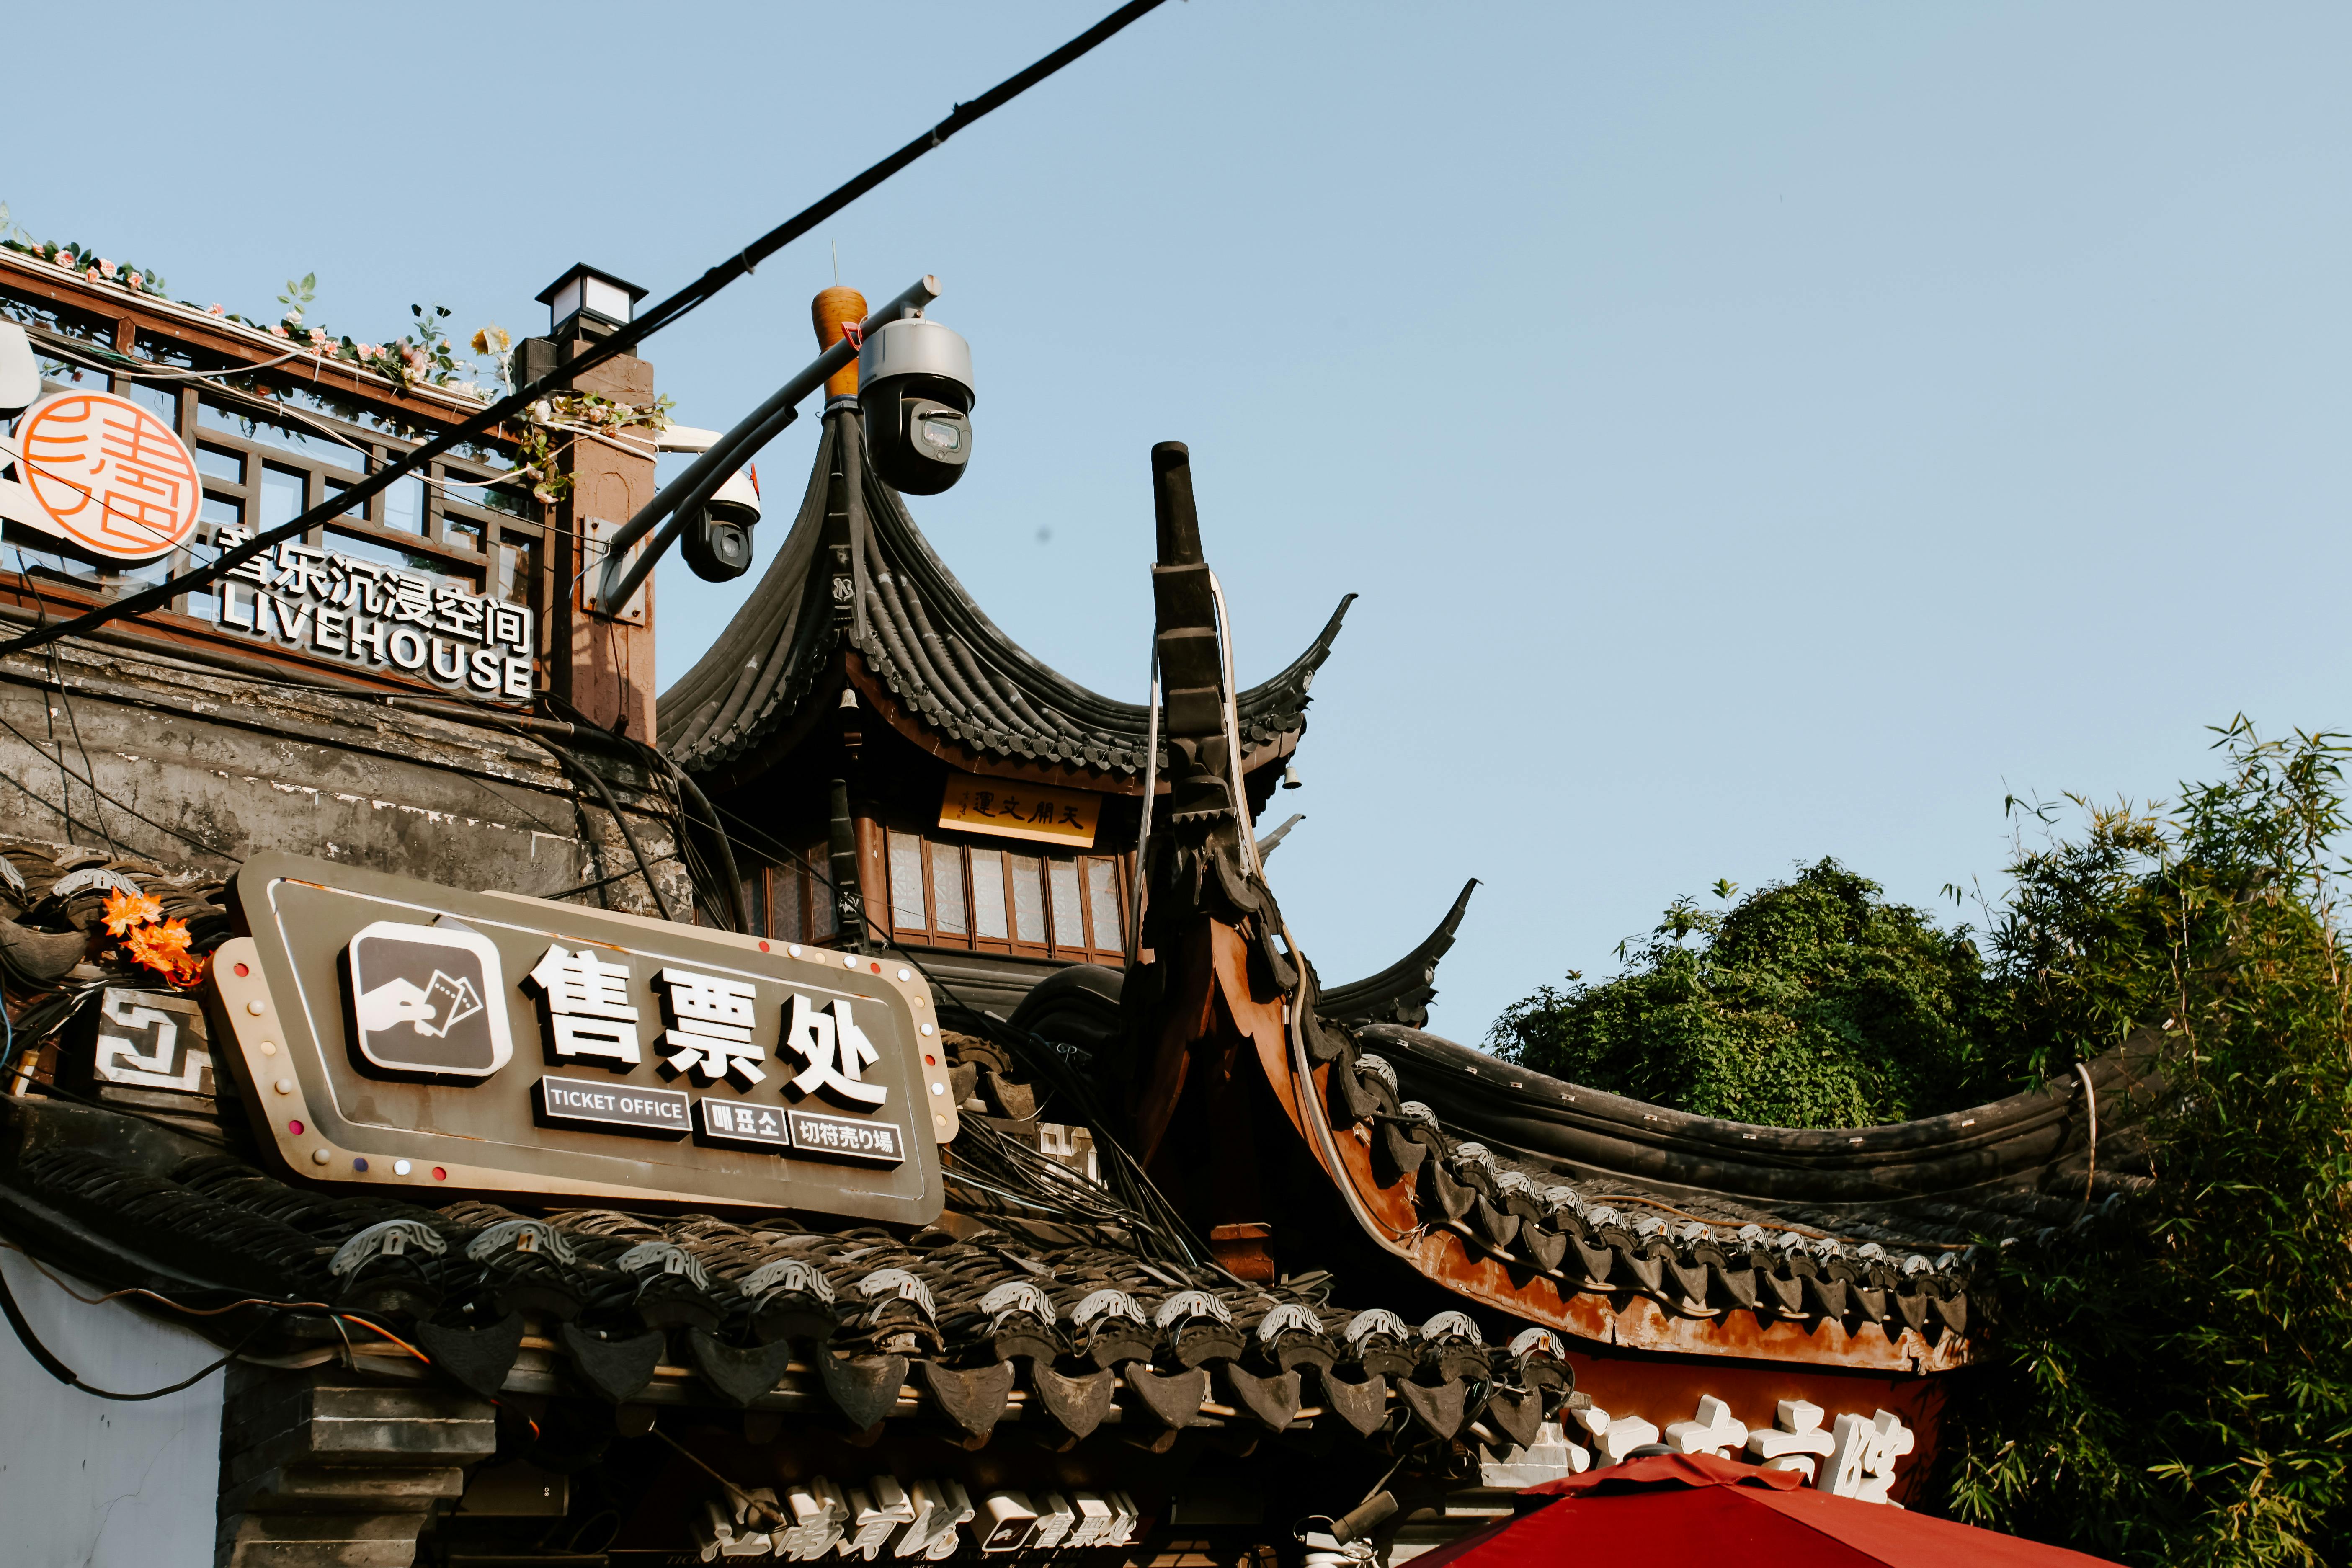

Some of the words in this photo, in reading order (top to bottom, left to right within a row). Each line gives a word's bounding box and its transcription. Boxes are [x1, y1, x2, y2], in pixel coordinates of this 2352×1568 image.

[218, 526, 531, 654] 音乐沉浸空间
[221, 583, 530, 699] LIVEHOUSE
[529, 943, 888, 1106] 售票处
[550, 1088, 615, 1111] TICKET
[620, 1097, 683, 1119] OFFICE
[712, 1104, 779, 1137] 매표소
[799, 1120, 894, 1154] 切符売り場
[666, 1555, 722, 1565] TICKT
